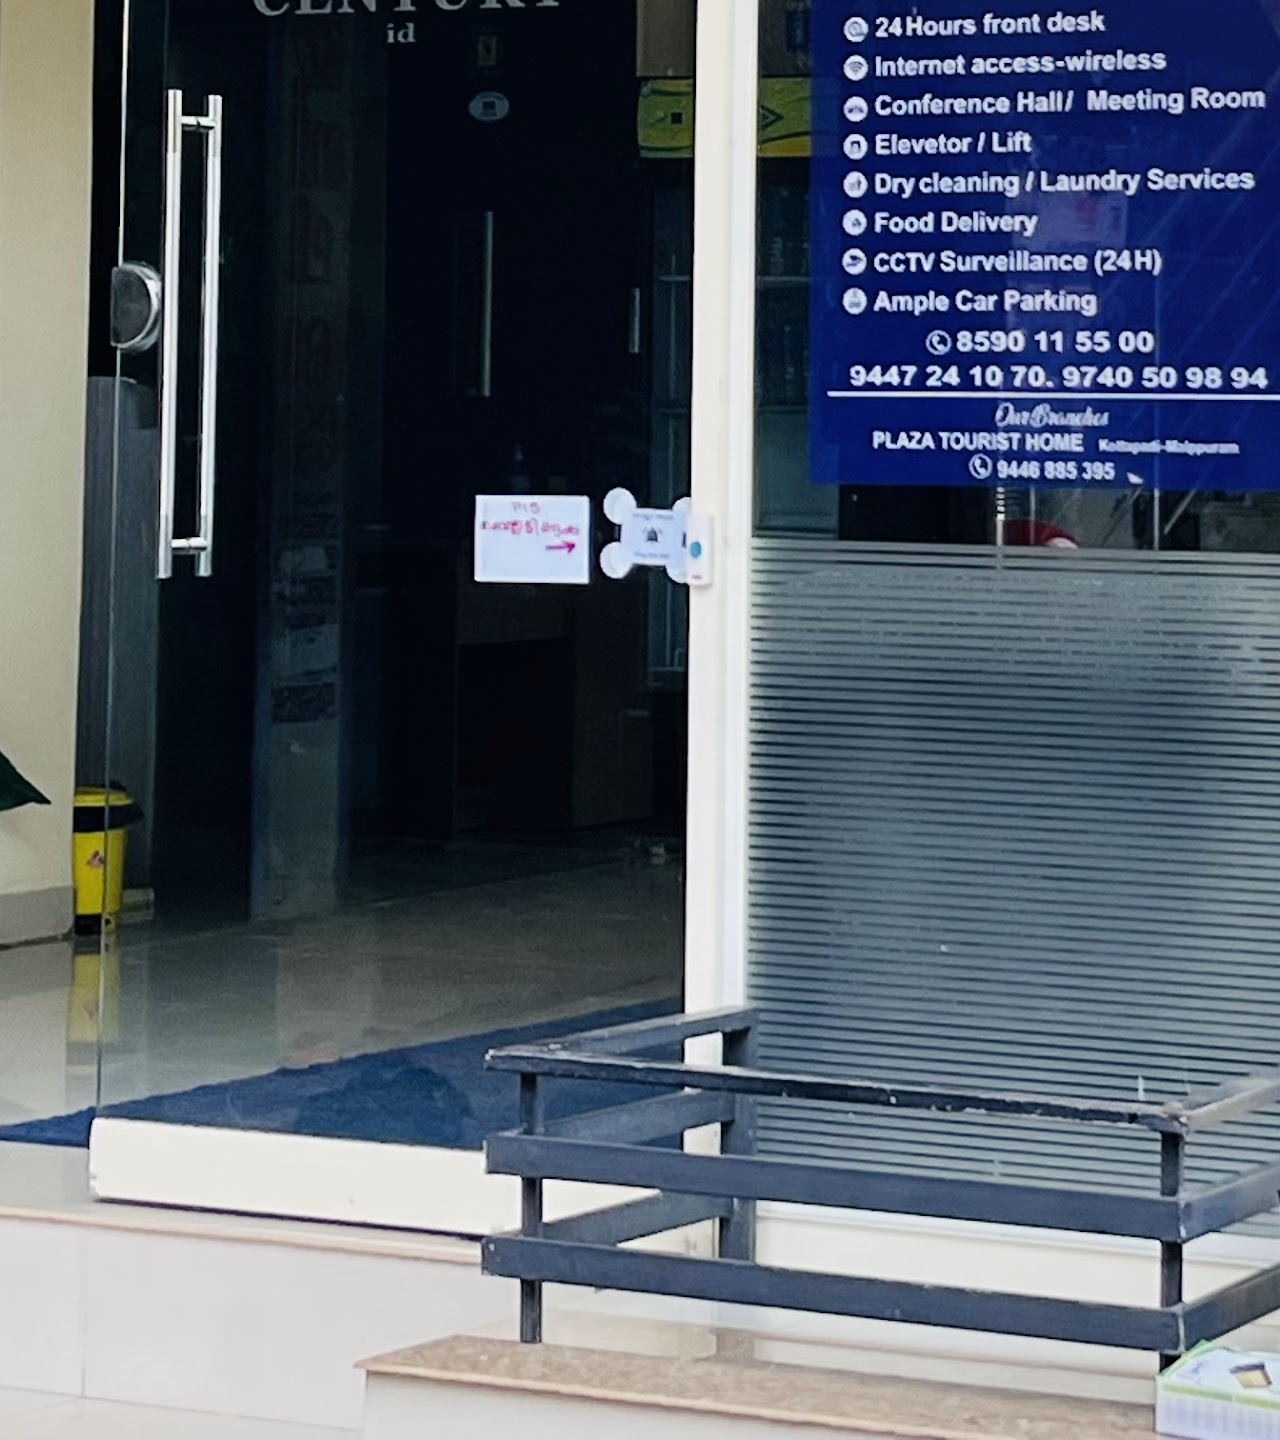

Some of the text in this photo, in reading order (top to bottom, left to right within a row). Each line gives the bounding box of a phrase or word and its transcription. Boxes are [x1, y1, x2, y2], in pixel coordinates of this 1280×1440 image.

[386, 23, 416, 44] id
[983, 13, 1041, 34] front
[1047, 10, 1105, 32] desk
[876, 50, 1166, 76] Internet access-wireless
[875, 93, 1010, 115] Conference
[1087, 89, 1184, 114] Meeting
[1191, 87, 1265, 108] Room
[875, 134, 972, 155] Elevetor
[992, 131, 1032, 152] Lift
[875, 173, 915, 198] Dry
[919, 171, 1020, 197] cleaning
[1041, 169, 1140, 195] Laundry
[1148, 168, 1255, 190] Services
[875, 211, 1038, 237] Food Delivery
[874, 252, 935, 272] CCTV
[940, 250, 1087, 272] Surveillance
[874, 290, 1097, 316] Ample Car Parking
[957, 330, 1154, 352] 8590 11 55 00
[850, 365, 917, 386] 9447
[926, 366, 960, 386] 24
[970, 366, 1003, 386] 10
[1063, 366, 1133, 387] 9740
[1142, 367, 1177, 388] 50
[1186, 367, 1222, 388] 98
[1231, 367, 1268, 388] 94
[873, 431, 1084, 452] PLAZA TOURIST HOME
[997, 460, 1040, 478] 9446
[1082, 462, 1115, 480] 395
